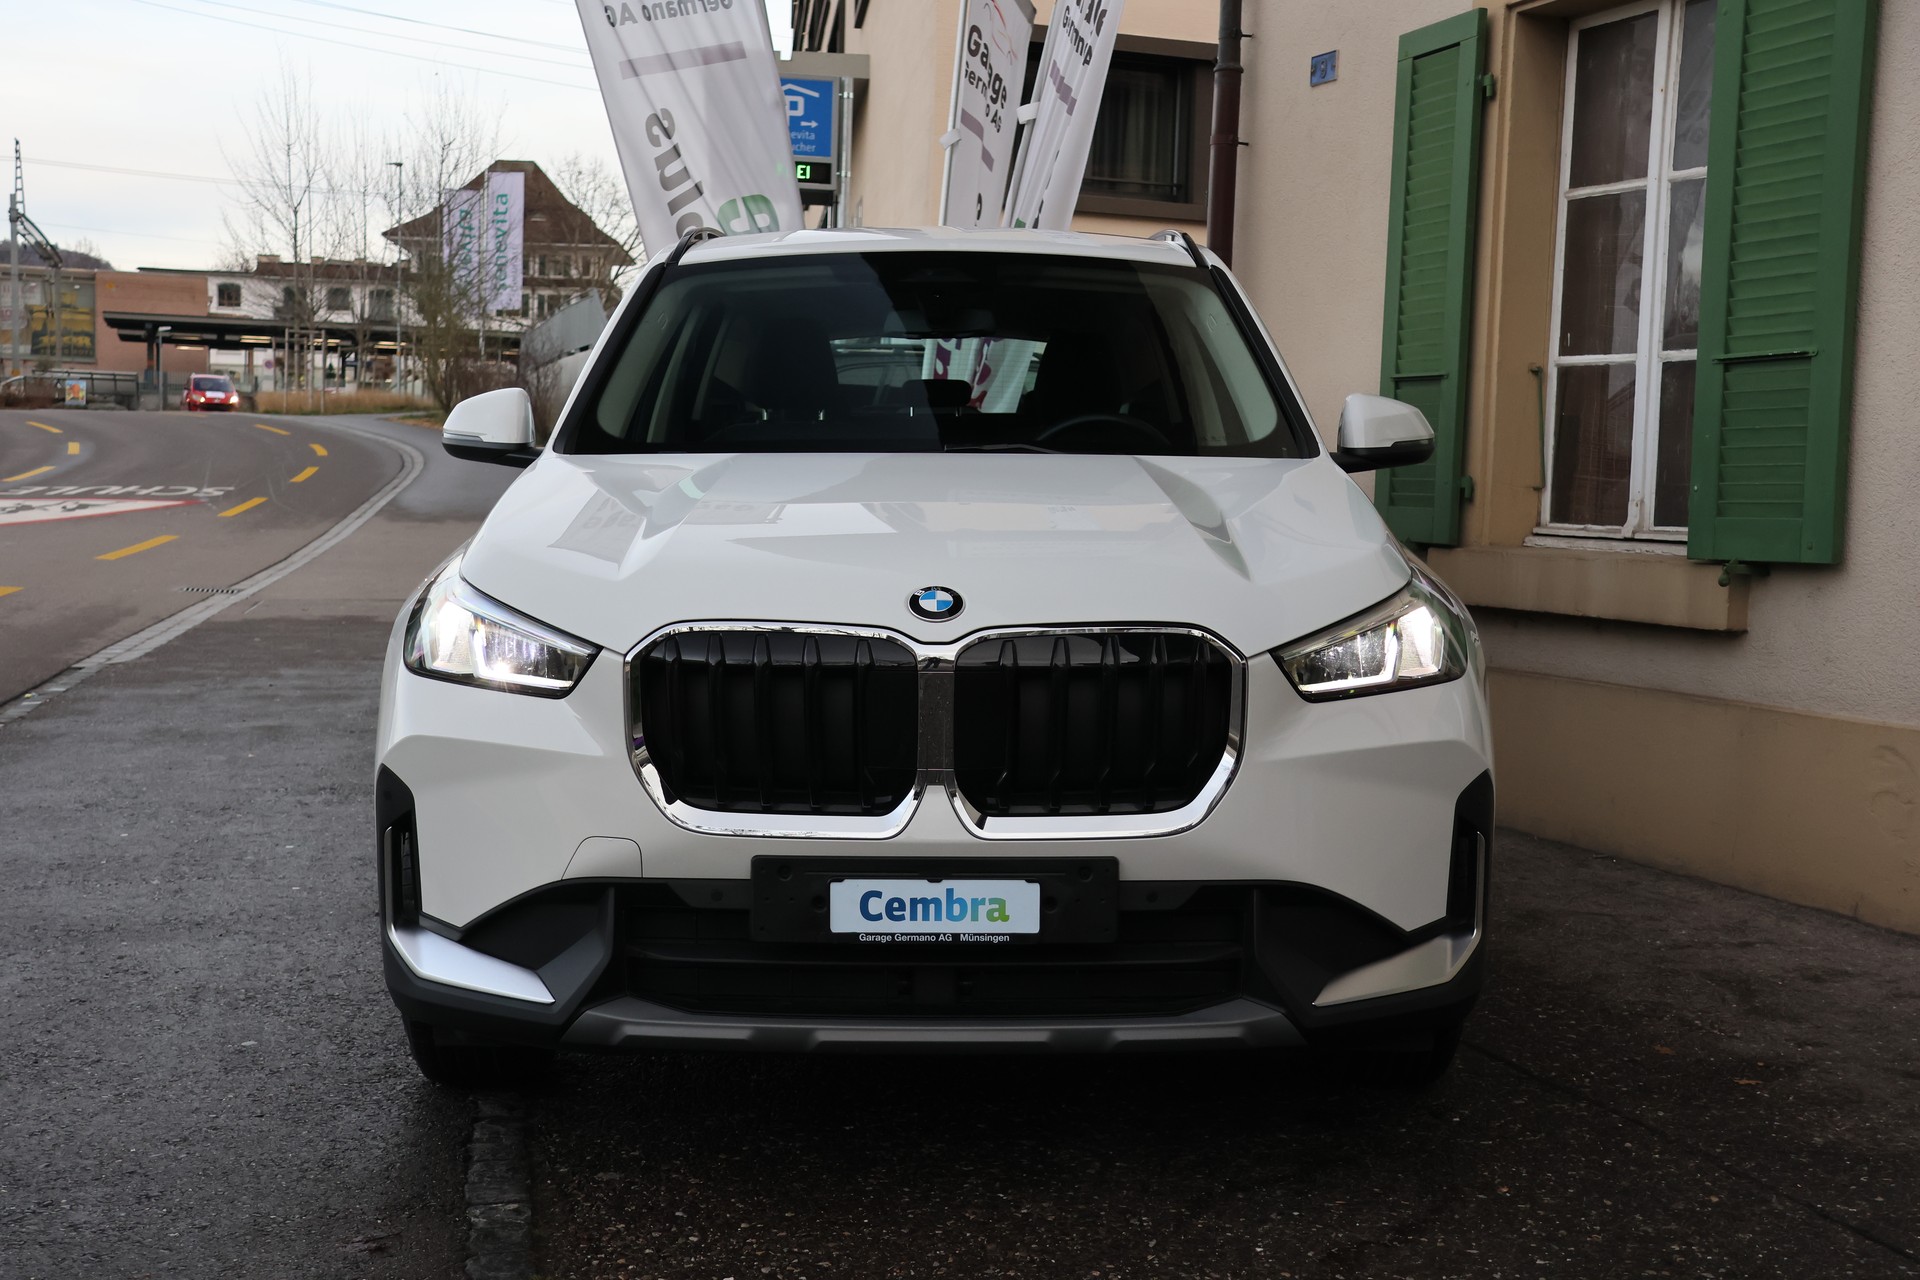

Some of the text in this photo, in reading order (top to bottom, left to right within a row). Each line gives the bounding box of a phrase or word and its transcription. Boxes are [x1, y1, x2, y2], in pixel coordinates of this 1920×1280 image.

[790, 129, 816, 141] evita
[796, 164, 811, 180] EI
[859, 887, 1010, 923] Cembra
[859, 933, 1010, 943] Garage Germano AG Münsingen
